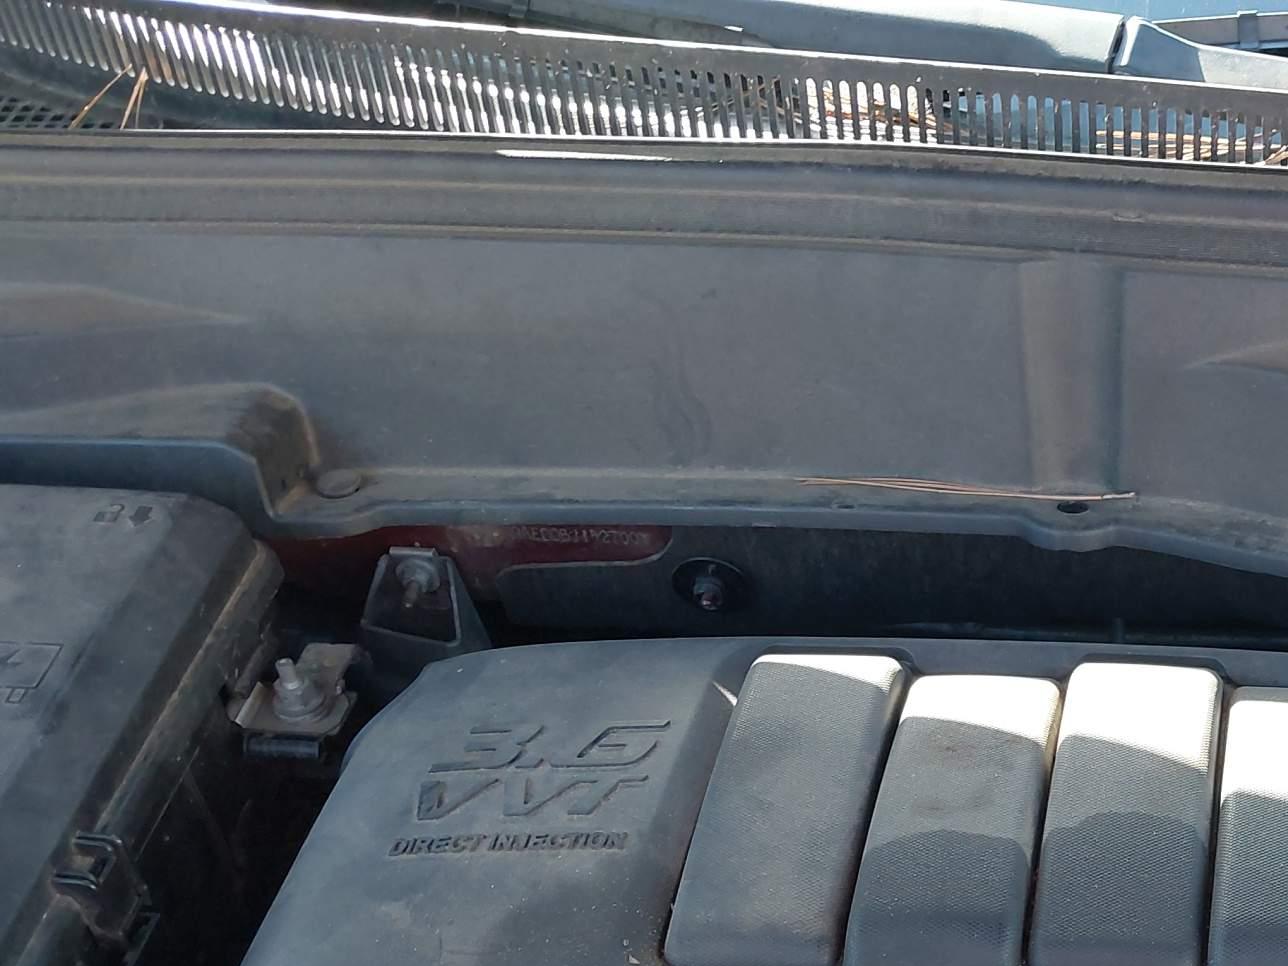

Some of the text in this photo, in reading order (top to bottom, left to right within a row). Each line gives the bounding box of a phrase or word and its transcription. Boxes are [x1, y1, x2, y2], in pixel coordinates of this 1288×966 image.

[427, 720, 672, 774] 3.6
[415, 774, 650, 821] VVT
[388, 831, 629, 857] DIRECT INJECTION
